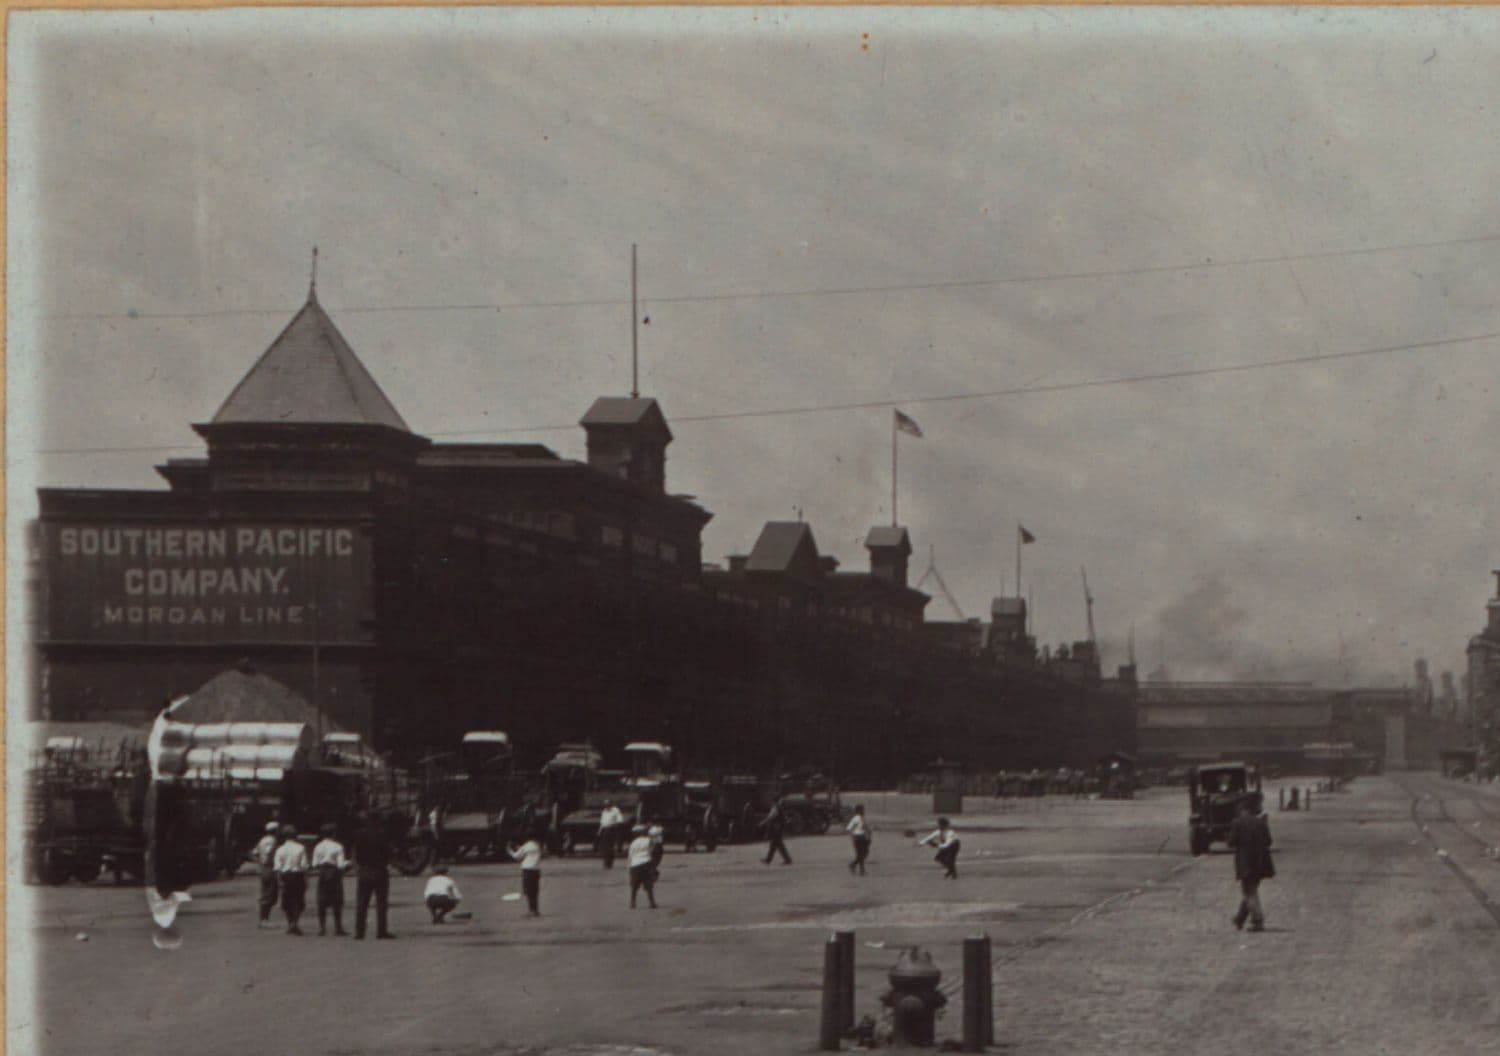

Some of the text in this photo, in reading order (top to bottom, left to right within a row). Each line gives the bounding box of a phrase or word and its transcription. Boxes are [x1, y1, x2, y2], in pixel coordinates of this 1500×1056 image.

[59, 528, 354, 556] SOUTHERN PACIFIC
[124, 567, 290, 596] COMPANY.
[103, 604, 305, 626] MORGAN LINE
